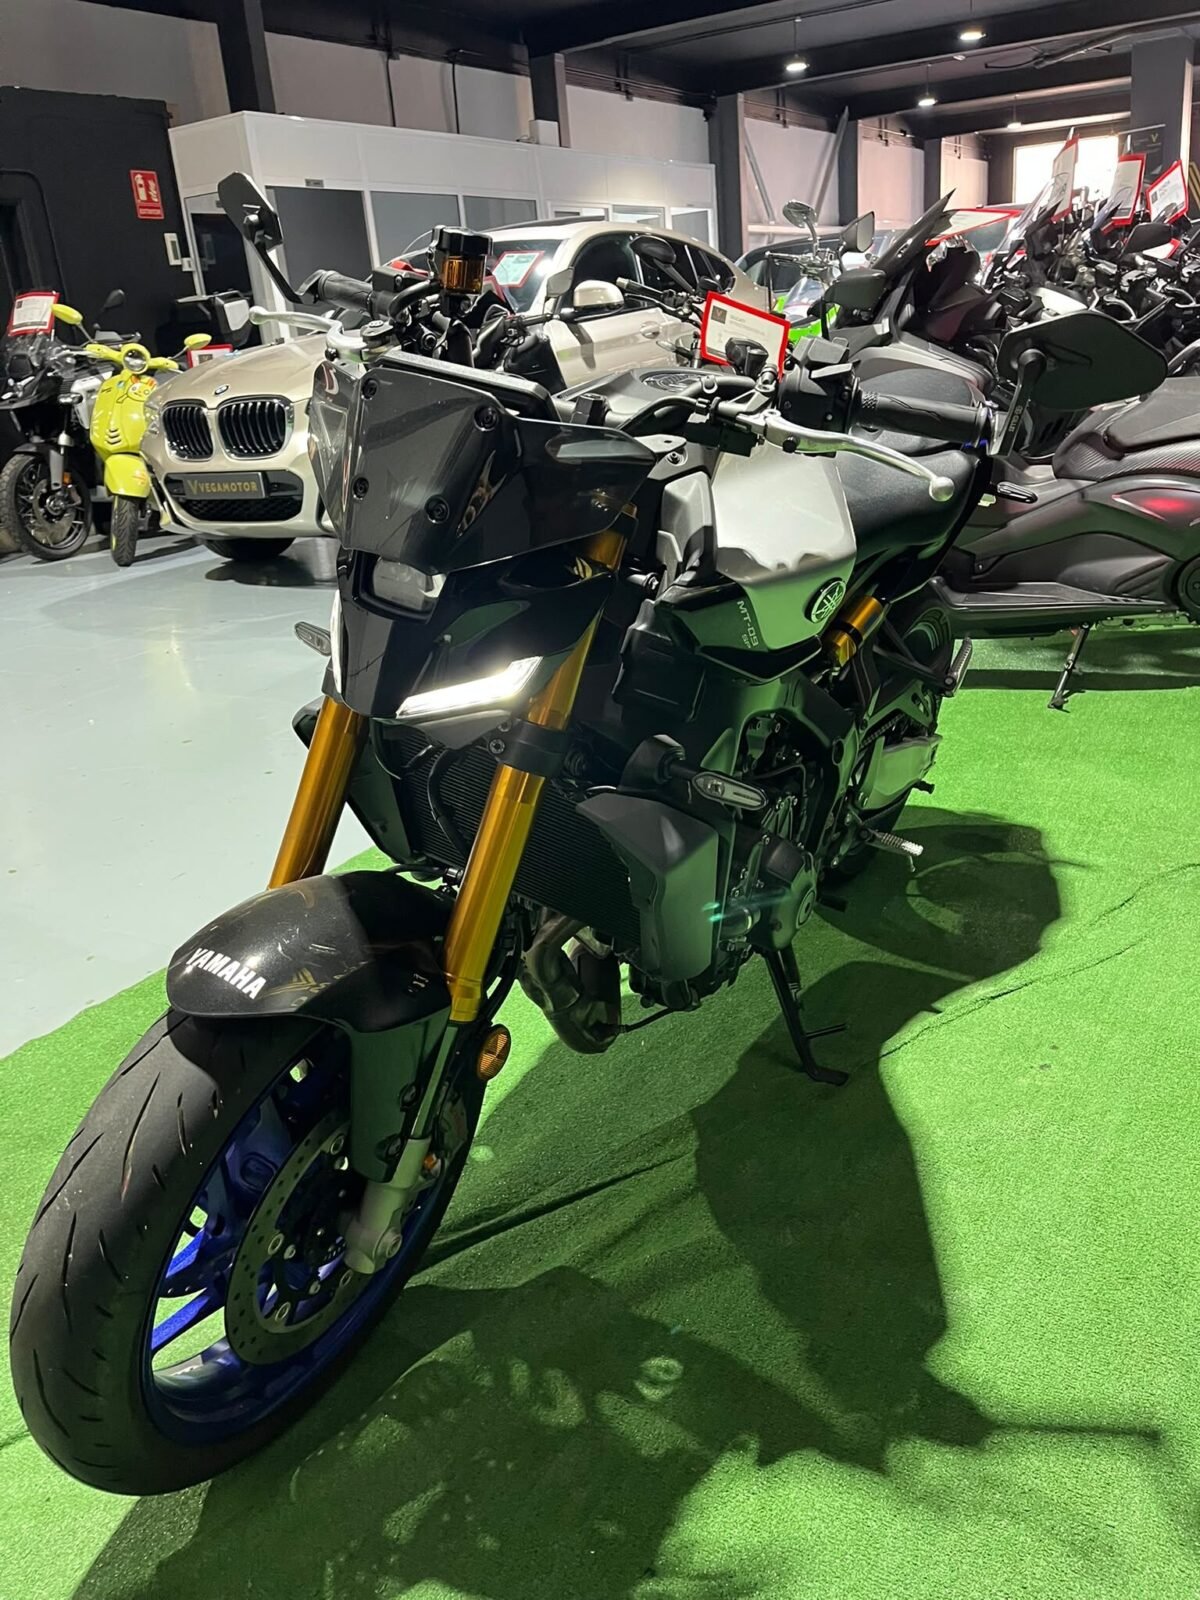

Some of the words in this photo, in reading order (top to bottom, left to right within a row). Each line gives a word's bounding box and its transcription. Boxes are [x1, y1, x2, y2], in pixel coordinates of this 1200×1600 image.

[199, 481, 257, 493] VEGAMOTOR
[737, 600, 759, 647] MT-09
[185, 947, 267, 1000] YAMAHA
